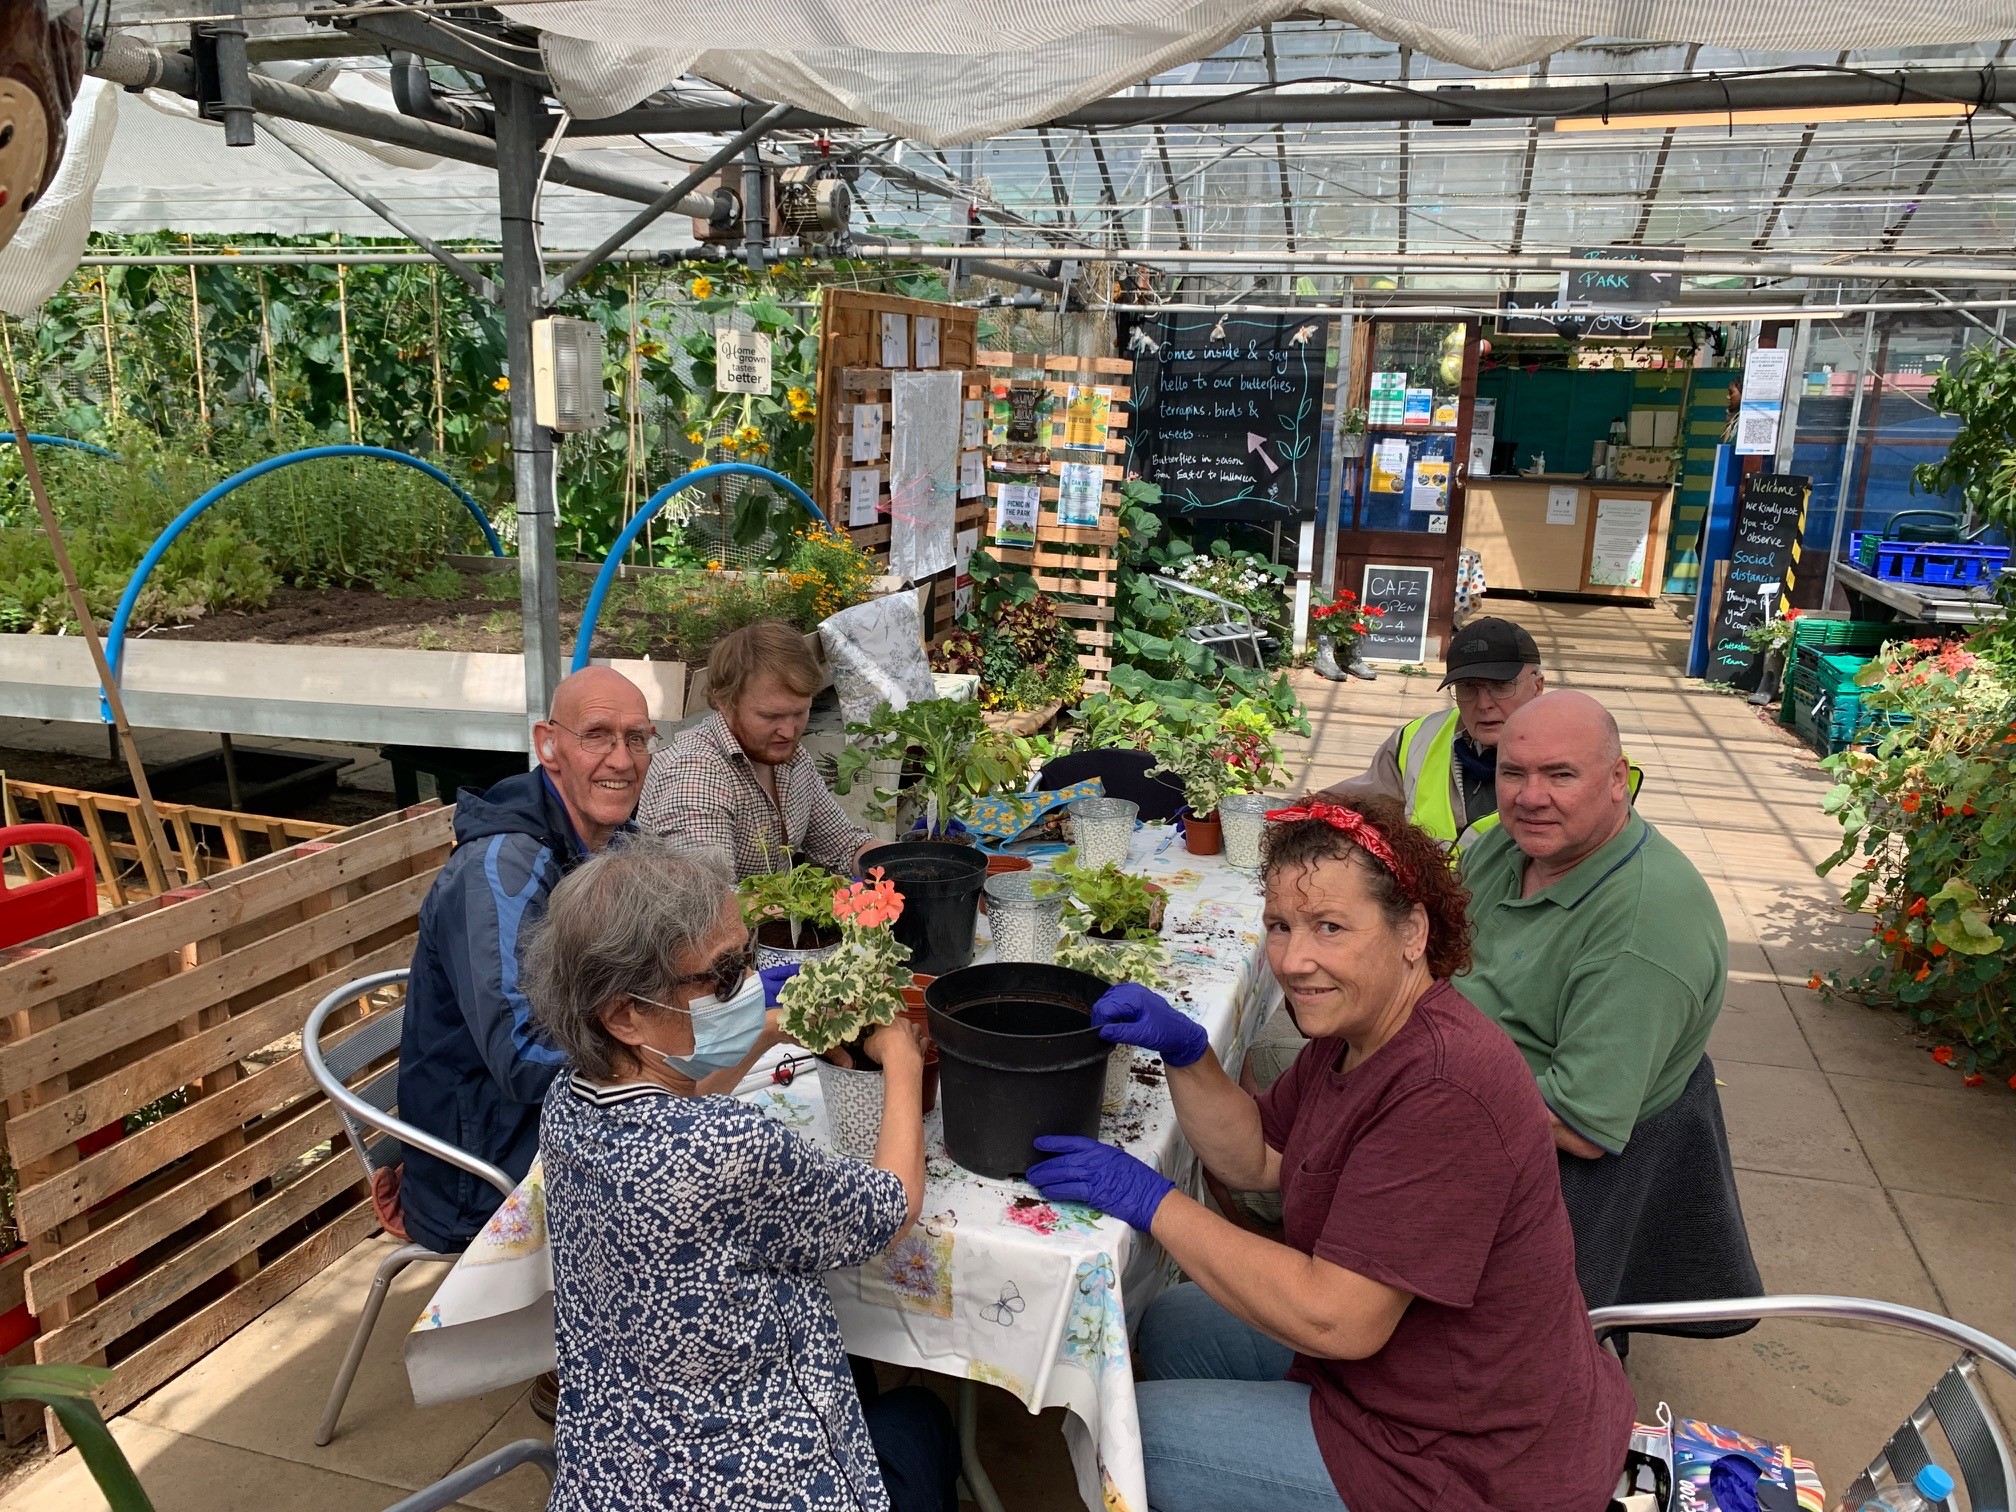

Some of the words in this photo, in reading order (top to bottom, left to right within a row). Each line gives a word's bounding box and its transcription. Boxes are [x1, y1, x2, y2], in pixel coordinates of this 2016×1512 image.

[1579, 271, 1629, 288] PARK
[721, 342, 756, 359] Home
[1159, 341, 1196, 364] Come
[1204, 342, 1240, 361] inside
[1247, 340, 1259, 360] &
[1268, 349, 1288, 375] say
[739, 355, 766, 364] grown
[732, 364, 756, 372] tastes
[728, 370, 762, 384] better
[1160, 370, 1188, 391] hello
[1193, 372, 1207, 389] to
[1213, 376, 1234, 388] our
[1215, 401, 1242, 418] birds
[1248, 400, 1259, 418] &
[1152, 452, 1197, 466] Butterflies
[1201, 454, 1212, 463] in
[1215, 456, 1244, 466] season
[1154, 469, 1171, 481] from
[1176, 468, 1205, 480] Easter
[1207, 469, 1217, 480] to
[1220, 470, 1258, 483] Halloween
[1752, 479, 1797, 496] Welcome
[1005, 508, 1015, 516] THE
[1017, 509, 1031, 517] PARK
[1007, 500, 1024, 508] PICNIC
[1025, 501, 1031, 509] IN
[1758, 502, 1782, 523] kindly
[1783, 507, 1799, 515] ask
[1740, 517, 1757, 535] you
[1760, 520, 1774, 531] to
[1747, 532, 1785, 548] observe
[1733, 550, 1776, 567] Social
[1371, 577, 1421, 596] CAFE
[1378, 599, 1418, 613] OPEN
[1725, 609, 1746, 625] your
[1717, 654, 1749, 667] Team
